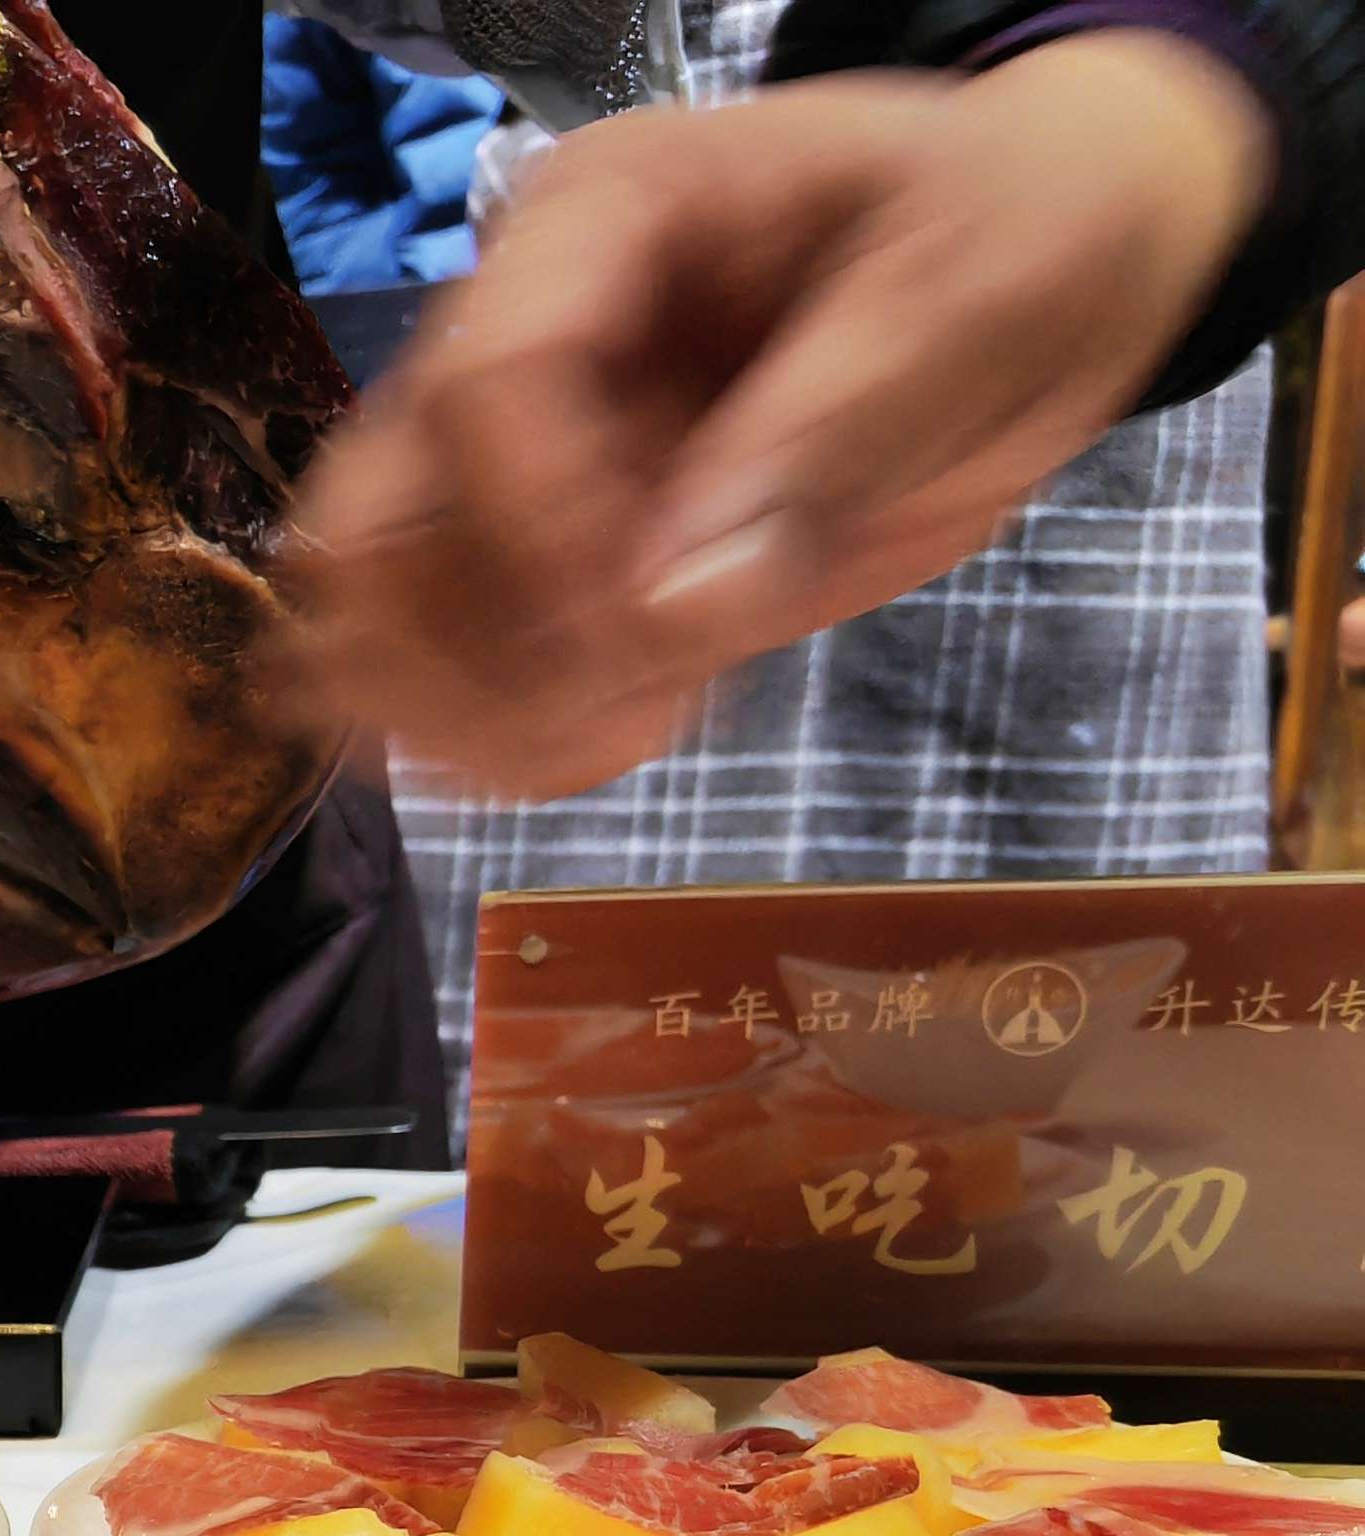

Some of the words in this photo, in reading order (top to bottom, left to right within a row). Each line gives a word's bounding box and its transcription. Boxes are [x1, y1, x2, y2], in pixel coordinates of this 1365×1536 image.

[650, 984, 933, 1040] 百年品牌
[1146, 979, 1365, 1036] 升达传
[585, 1136, 1365, 1276] 生吃切
